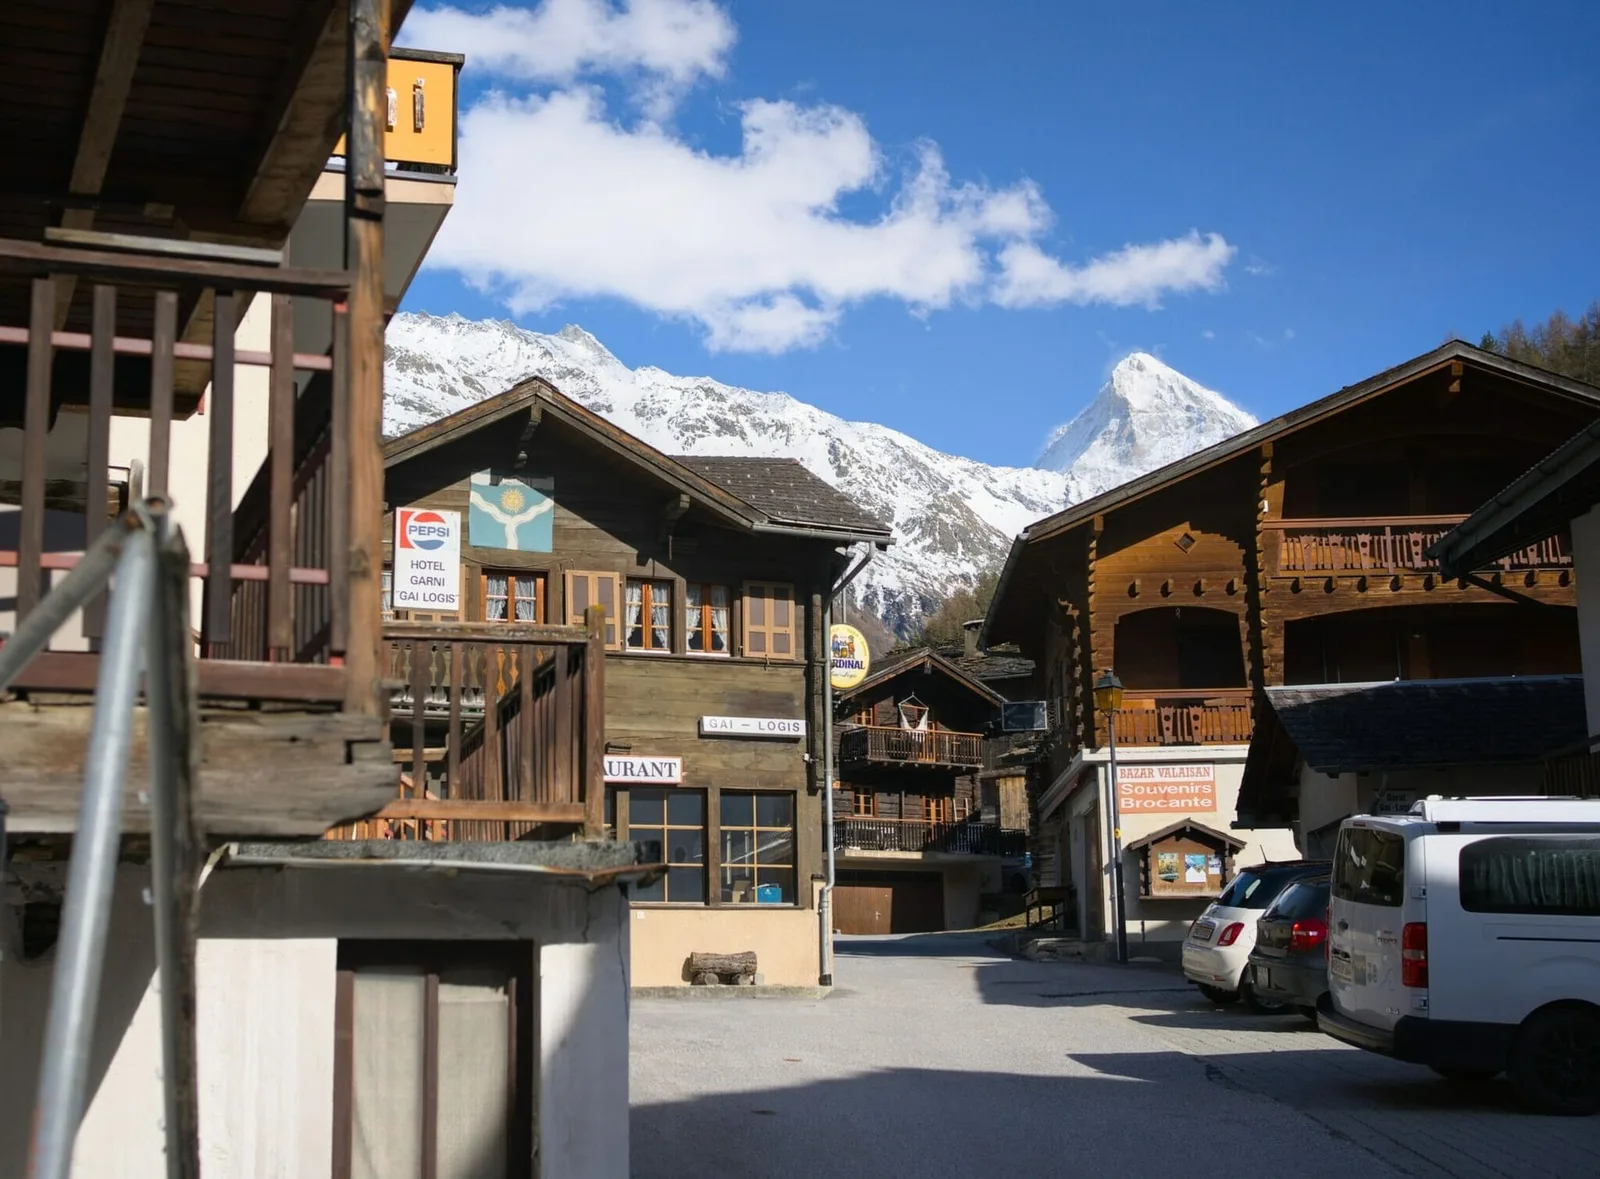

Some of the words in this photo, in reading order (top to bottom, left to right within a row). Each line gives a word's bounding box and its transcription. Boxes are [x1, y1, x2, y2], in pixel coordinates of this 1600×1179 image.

[408, 525, 450, 537] PEPSI
[410, 560, 445, 571] HOTEL
[410, 575, 445, 587] GARNI
[831, 660, 865, 670] RDINAL
[709, 718, 733, 729] GAI
[758, 720, 800, 732] LOGIS
[1119, 767, 1154, 779] BAZAR
[1158, 766, 1211, 779] VALAISAN
[1121, 783, 1212, 795] Souvenirs
[1121, 797, 1212, 809] Brocante
